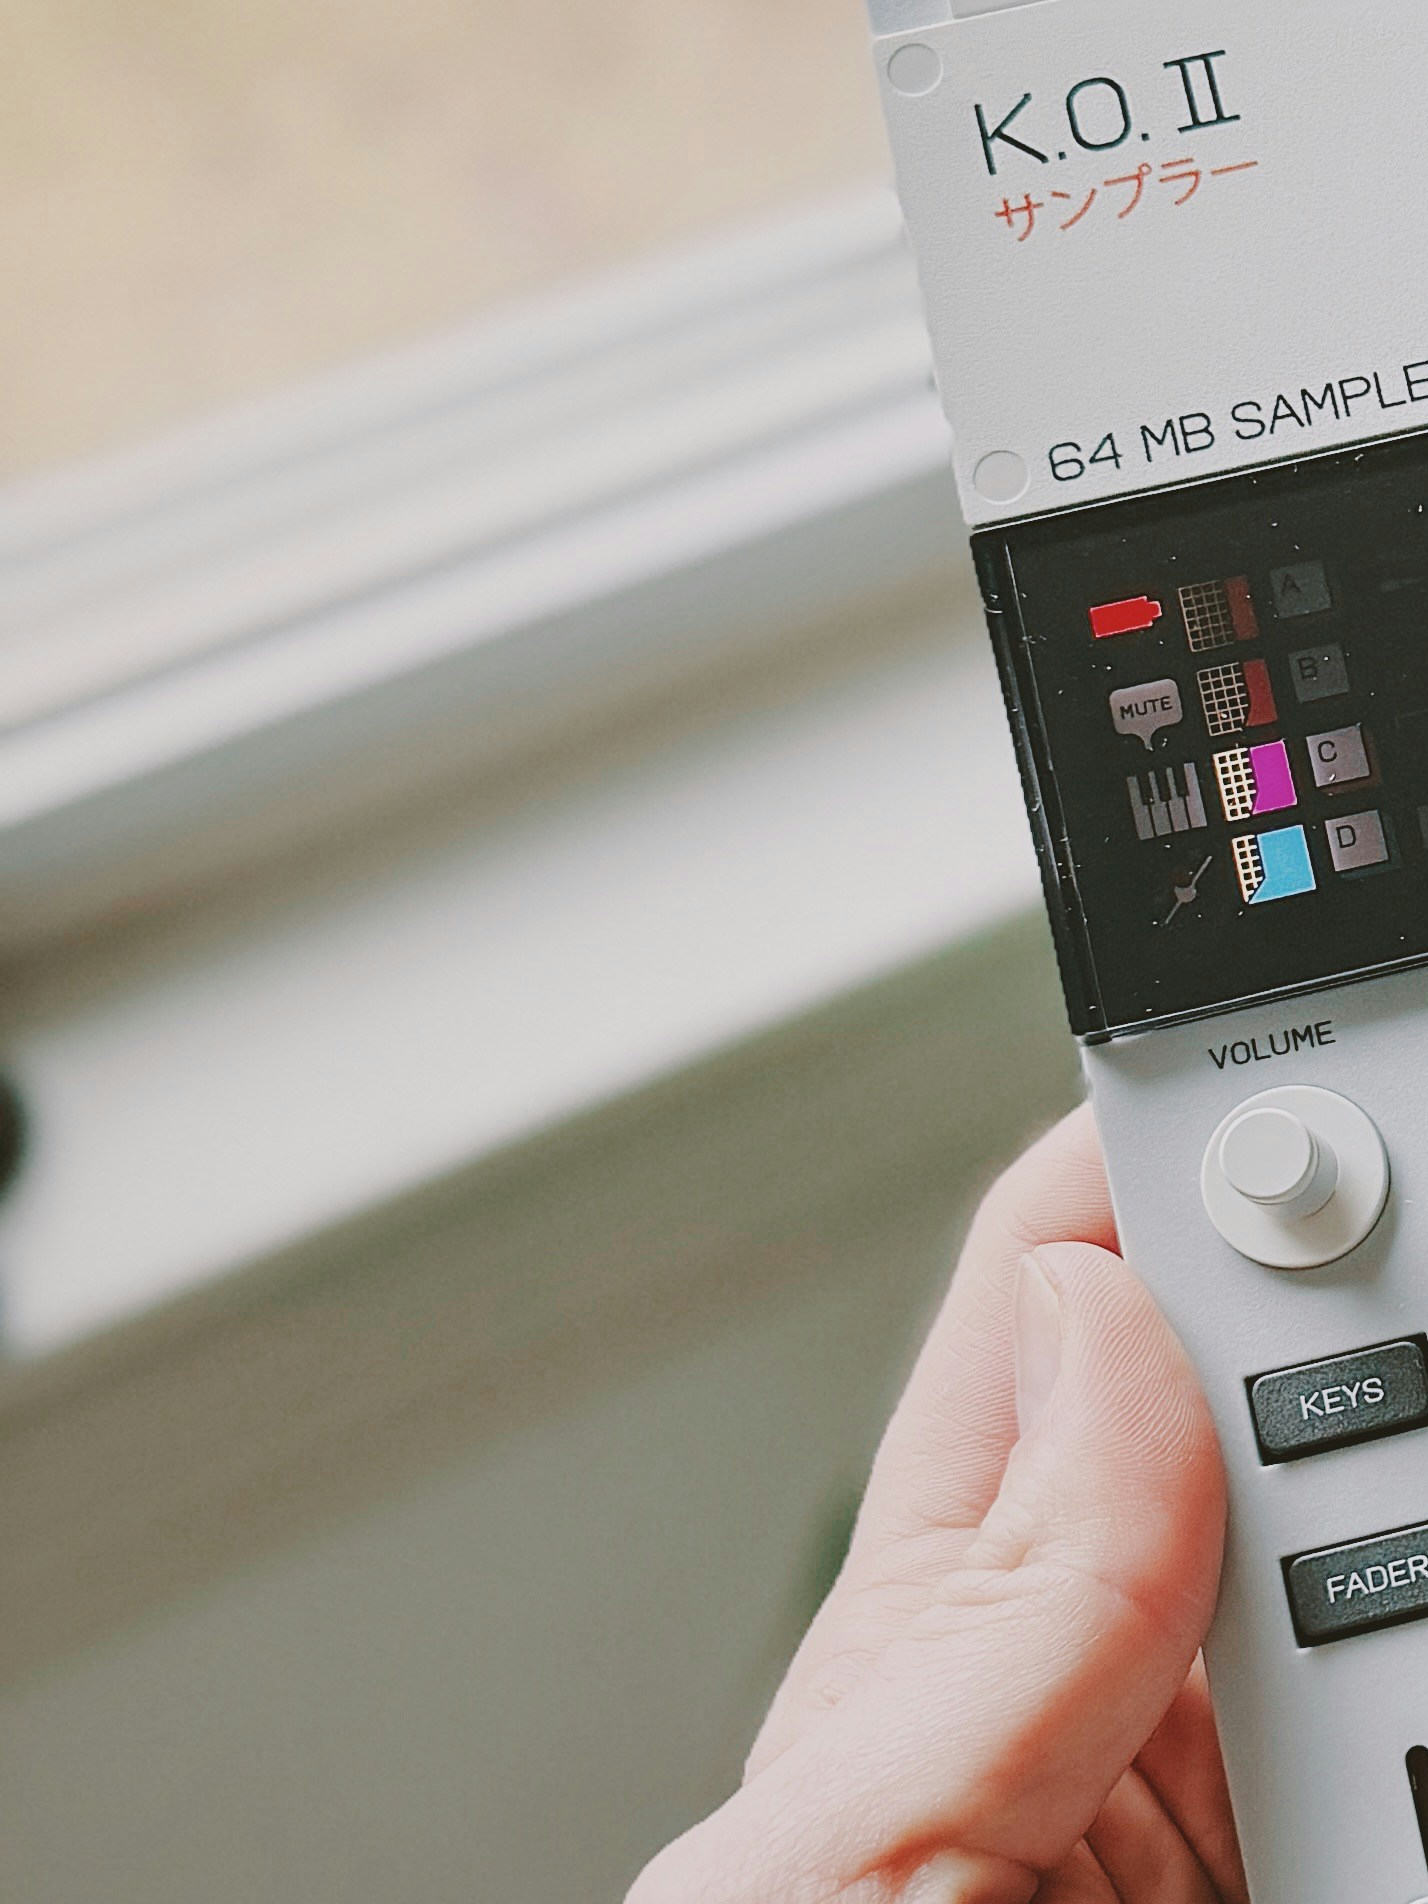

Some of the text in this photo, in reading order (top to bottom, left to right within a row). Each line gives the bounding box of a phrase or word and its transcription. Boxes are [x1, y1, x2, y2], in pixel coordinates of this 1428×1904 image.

[995, 158, 1258, 242] サンプラー
[1048, 432, 1122, 483] 64
[1139, 413, 1216, 463] MB
[1298, 655, 1317, 682] B
[1118, 694, 1175, 723] MUTE
[1316, 739, 1339, 764] C
[1336, 825, 1358, 849] D
[1208, 1019, 1337, 1071] VOLUME
[1300, 1377, 1385, 1421] KEYS
